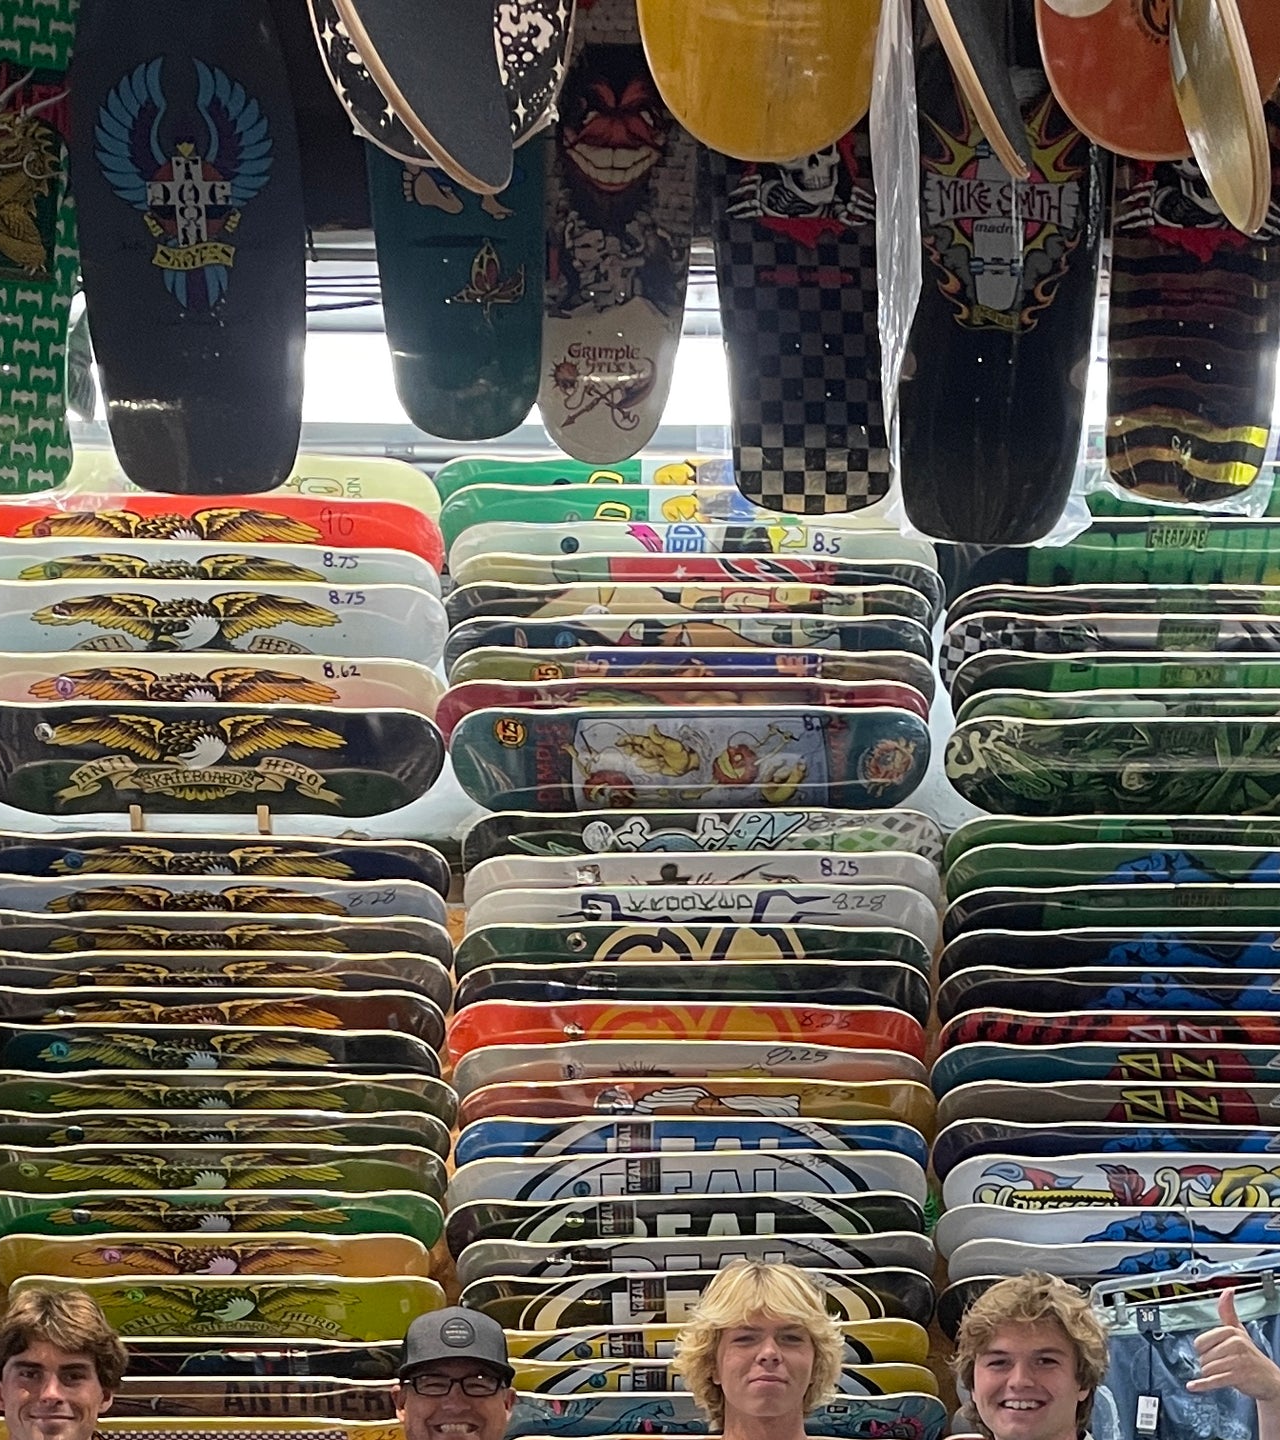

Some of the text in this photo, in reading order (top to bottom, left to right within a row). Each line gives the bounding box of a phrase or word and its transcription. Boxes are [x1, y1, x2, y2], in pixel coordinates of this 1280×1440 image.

[812, 534, 840, 554] 8.5
[323, 551, 358, 569] 8.75
[329, 590, 365, 604] 8.75
[324, 662, 361, 678] 8.62
[75, 758, 318, 789] ANTI SKATEBOARDS HERO
[819, 860, 859, 877] 8.25
